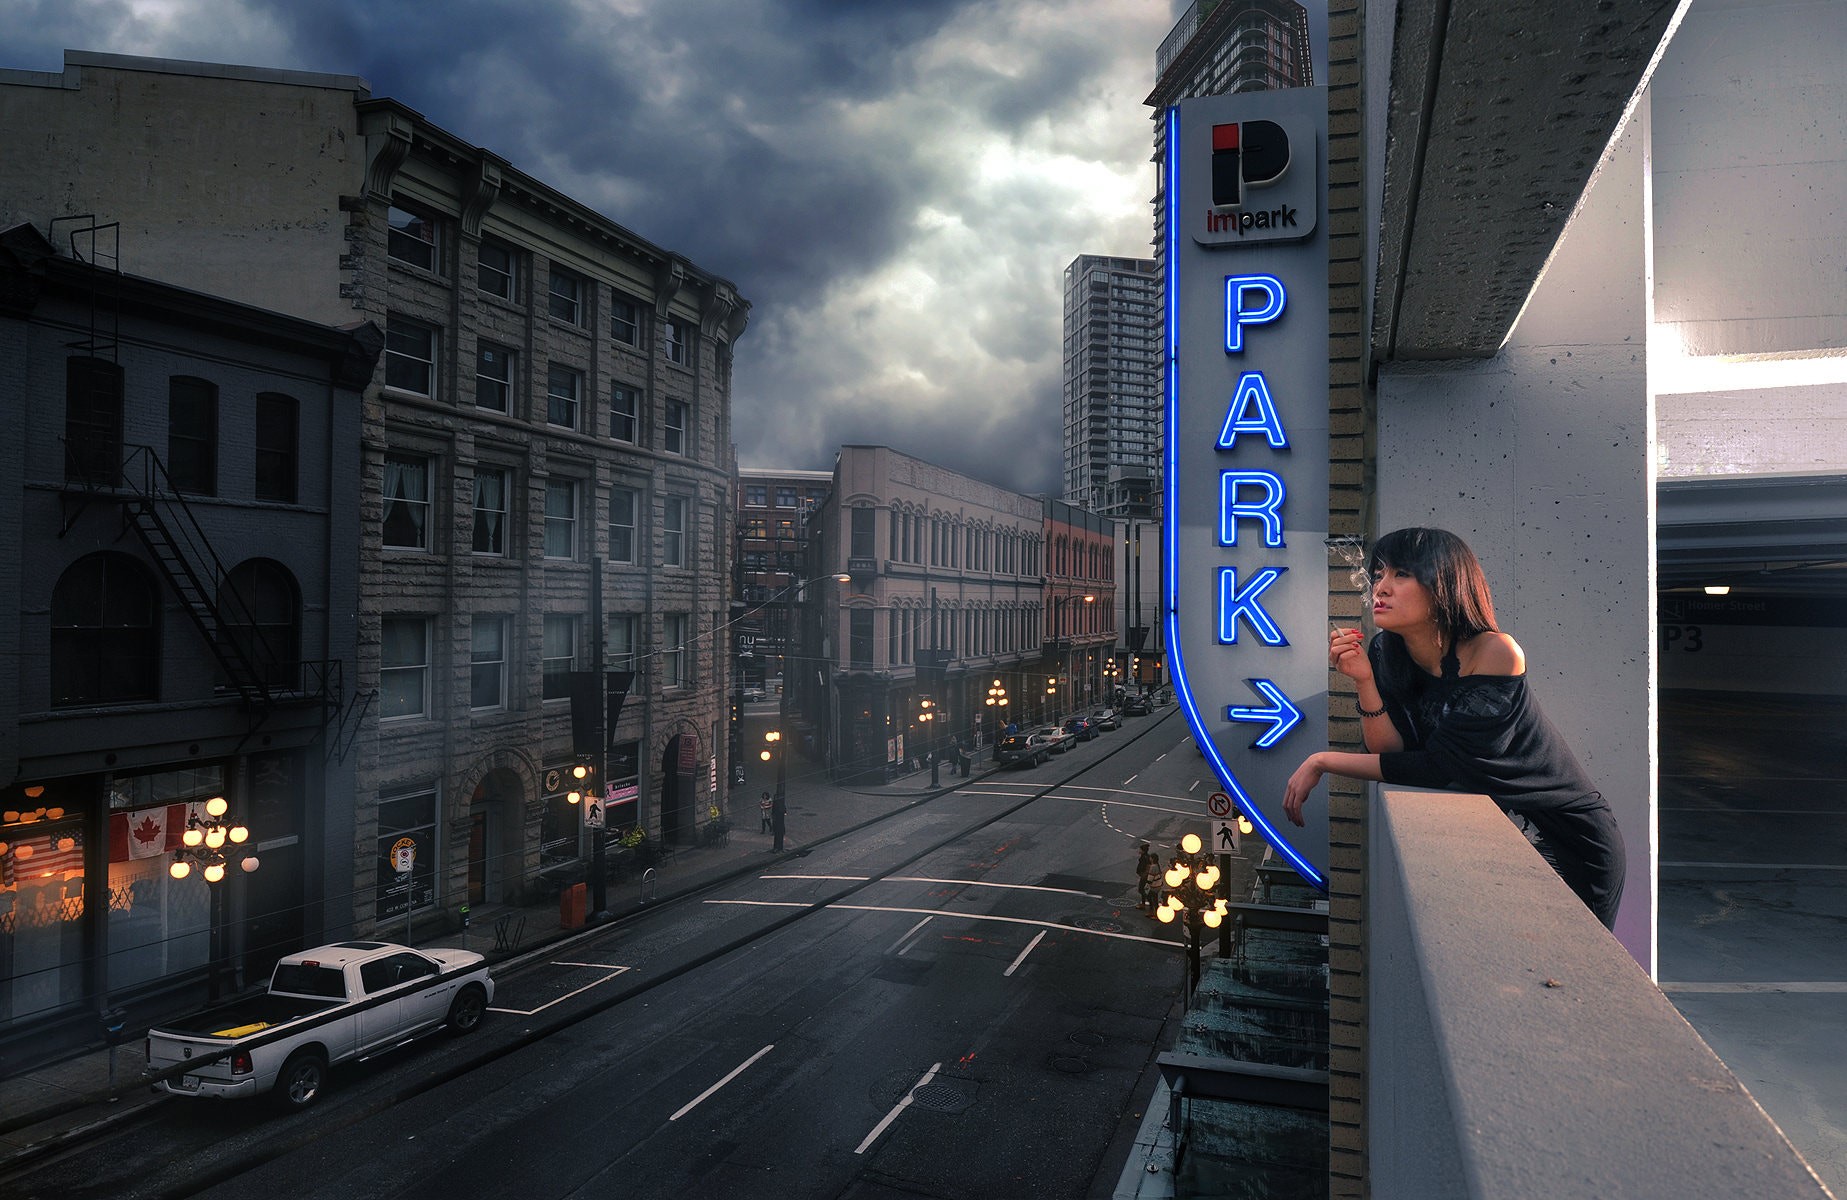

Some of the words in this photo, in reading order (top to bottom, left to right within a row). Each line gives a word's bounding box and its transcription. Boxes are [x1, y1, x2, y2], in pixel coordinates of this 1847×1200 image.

[1207, 204, 1297, 235] impark
[1214, 274, 1292, 647] PARK
[1688, 600, 1725, 610] Homer
[1729, 600, 1766, 611] Street
[1662, 625, 1703, 652] P3
